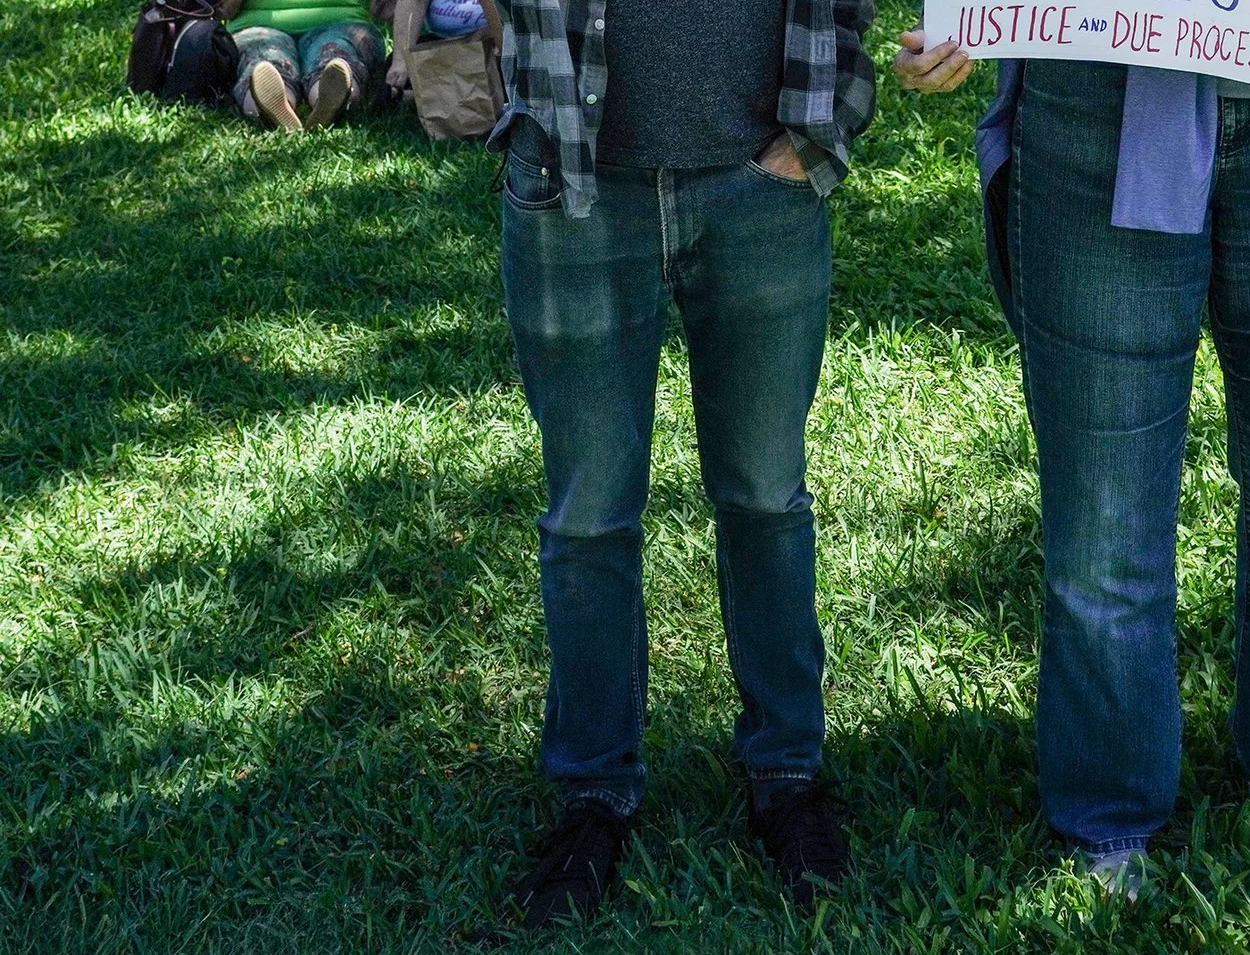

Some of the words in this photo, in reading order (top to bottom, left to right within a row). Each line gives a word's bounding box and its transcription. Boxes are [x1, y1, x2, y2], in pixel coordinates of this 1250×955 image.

[948, 5, 1077, 48] JUSTICE
[1078, 16, 1108, 33] AND
[1111, 10, 1164, 53] DUE
